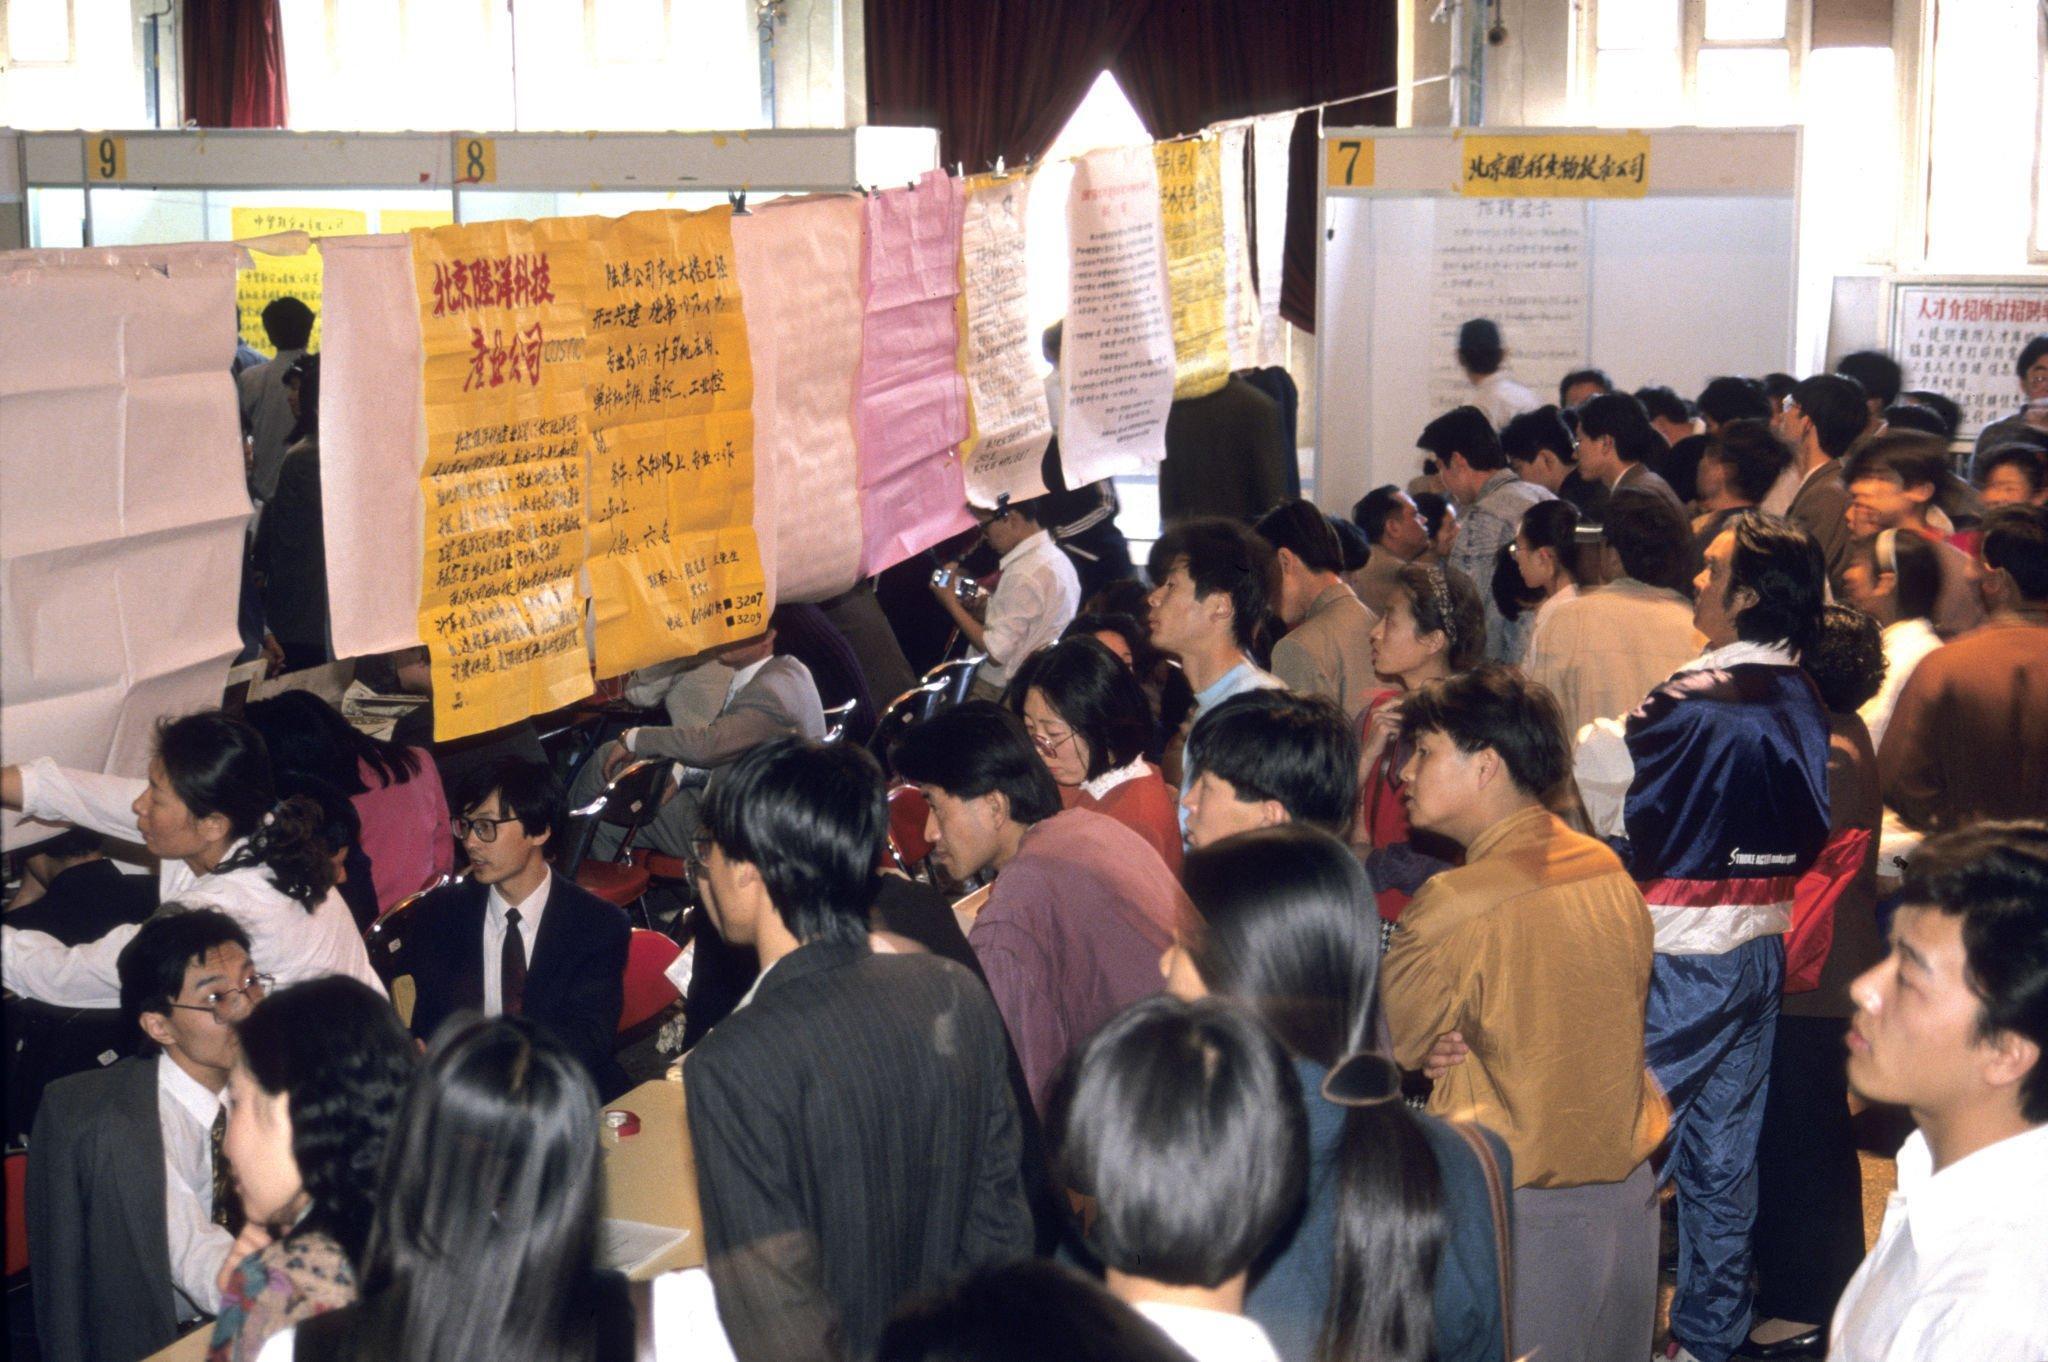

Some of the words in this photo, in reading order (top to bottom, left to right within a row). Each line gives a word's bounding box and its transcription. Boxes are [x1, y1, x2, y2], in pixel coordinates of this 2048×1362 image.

[99, 138, 116, 178] 9
[467, 140, 485, 184] 8
[1339, 142, 1361, 186] 7
[735, 591, 763, 610] 3207
[736, 612, 763, 627] 3209
